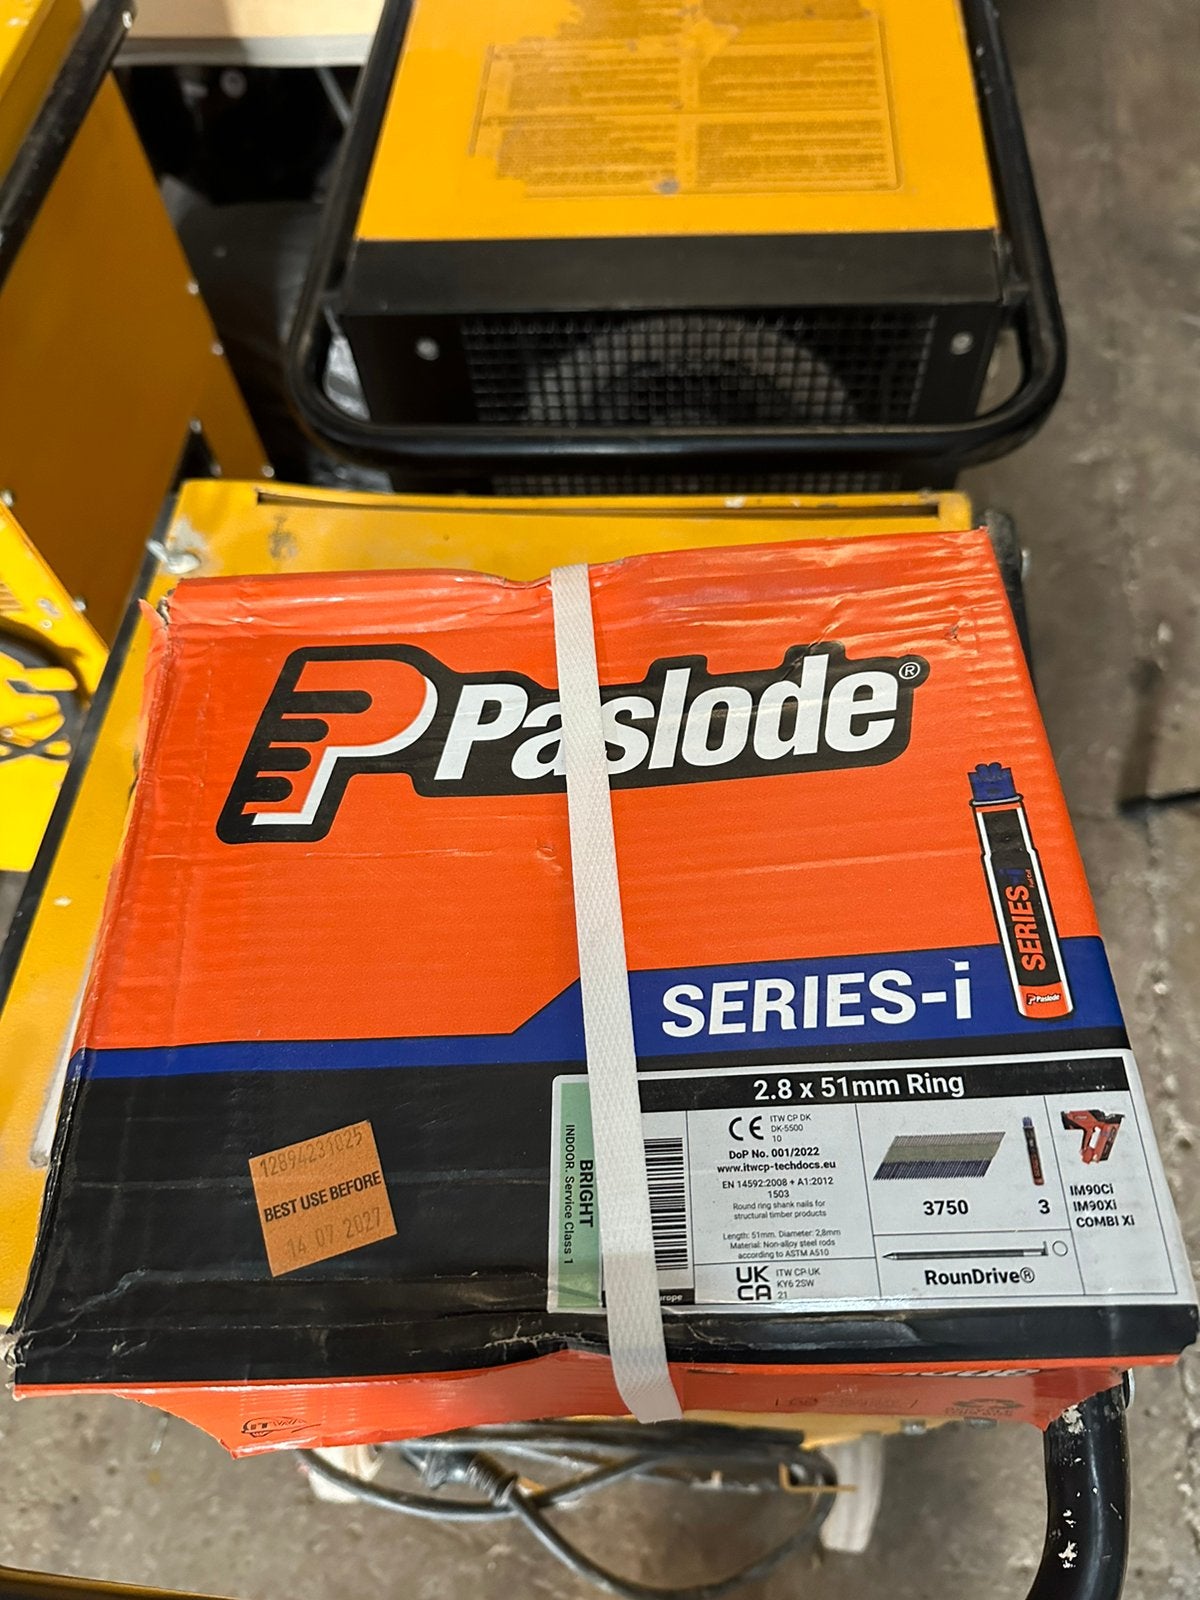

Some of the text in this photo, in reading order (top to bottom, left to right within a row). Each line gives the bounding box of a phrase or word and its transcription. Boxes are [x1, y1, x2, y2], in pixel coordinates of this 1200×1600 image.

[661, 960, 972, 1038] SERIES-i
[753, 1072, 966, 1101] 2.8 x 51mm Ring
[770, 1113, 812, 1123] ITW CP DK
[771, 1123, 804, 1133] DK-5500
[772, 1135, 782, 1143] 10
[565, 1124, 575, 1173] INDOOR.
[729, 1146, 820, 1160] DoP No. 001/2022
[717, 1161, 837, 1173] www.itwcp-techdocs.eu
[722, 1180, 735, 1189] EN
[737, 1178, 788, 1188] 14592:2008
[797, 1176, 834, 1186] A1:2012
[579, 1159, 594, 1229] BRIGHT
[768, 1189, 790, 1199] 1503
[1070, 1183, 1115, 1196] IM90Ci
[263, 1170, 383, 1223] BEST USE BEFORE
[564, 1175, 575, 1219] Service
[733, 1199, 826, 1211] Round ring shank nails for
[922, 1199, 1051, 1216] 3750 3
[1073, 1199, 1118, 1212] IM90Xi
[734, 1209, 827, 1220] structural timber products
[1076, 1214, 1136, 1228] COMBI Xi
[315, 1224, 334, 1248] 07
[343, 1206, 382, 1239] 2027
[563, 1222, 574, 1255] Class
[722, 1231, 750, 1241] Length:
[778, 1229, 813, 1238] Diameter:
[815, 1228, 841, 1237] 2,8mm
[730, 1238, 836, 1250] Material: Non-alloy steel rods
[738, 1248, 830, 1260] according to ASTM A510
[736, 1265, 770, 1284] UK
[776, 1267, 821, 1277] ITW CP UK
[776, 1279, 815, 1288] KY6 2SW
[737, 1284, 772, 1301] CA
[777, 1291, 788, 1300] 21
